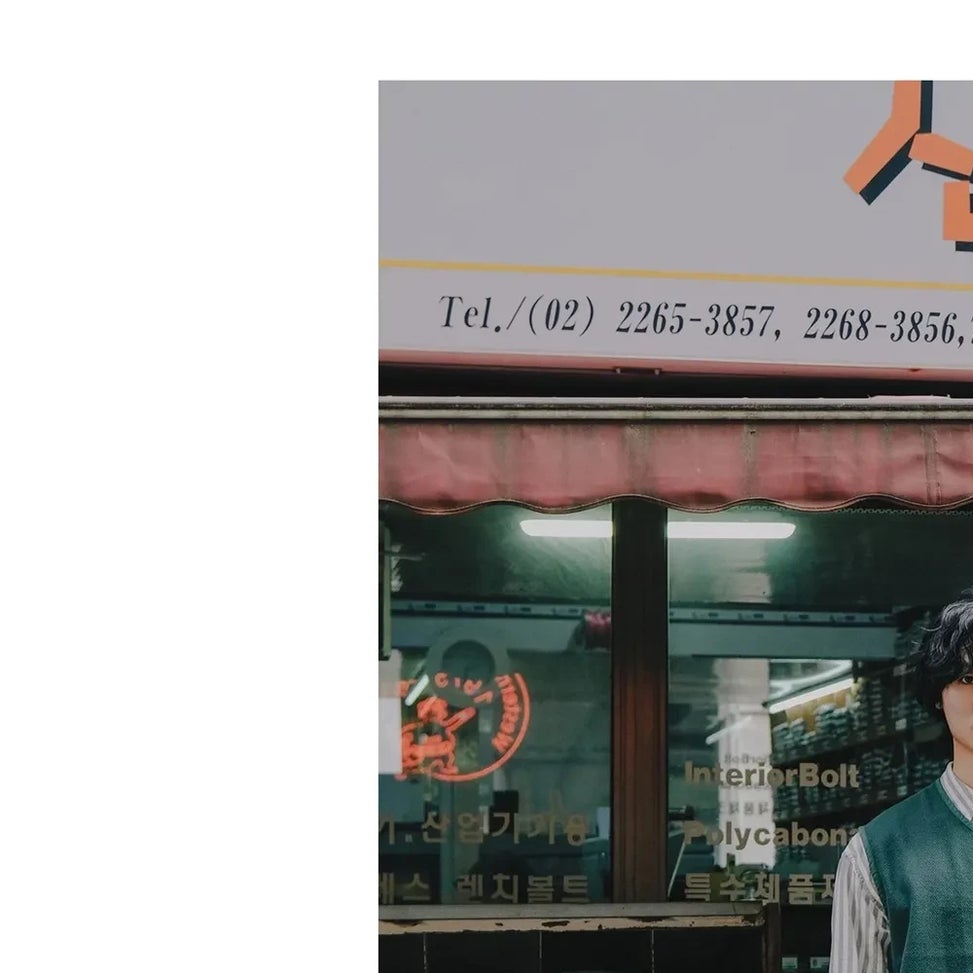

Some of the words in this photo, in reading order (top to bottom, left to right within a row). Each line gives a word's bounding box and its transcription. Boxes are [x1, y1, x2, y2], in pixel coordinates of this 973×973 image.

[440, 294, 594, 336] Tel./(02)
[616, 300, 782, 342] 2265-3857,
[684, 761, 860, 788] InteriorBolt
[683, 820, 858, 850] Polycabon
